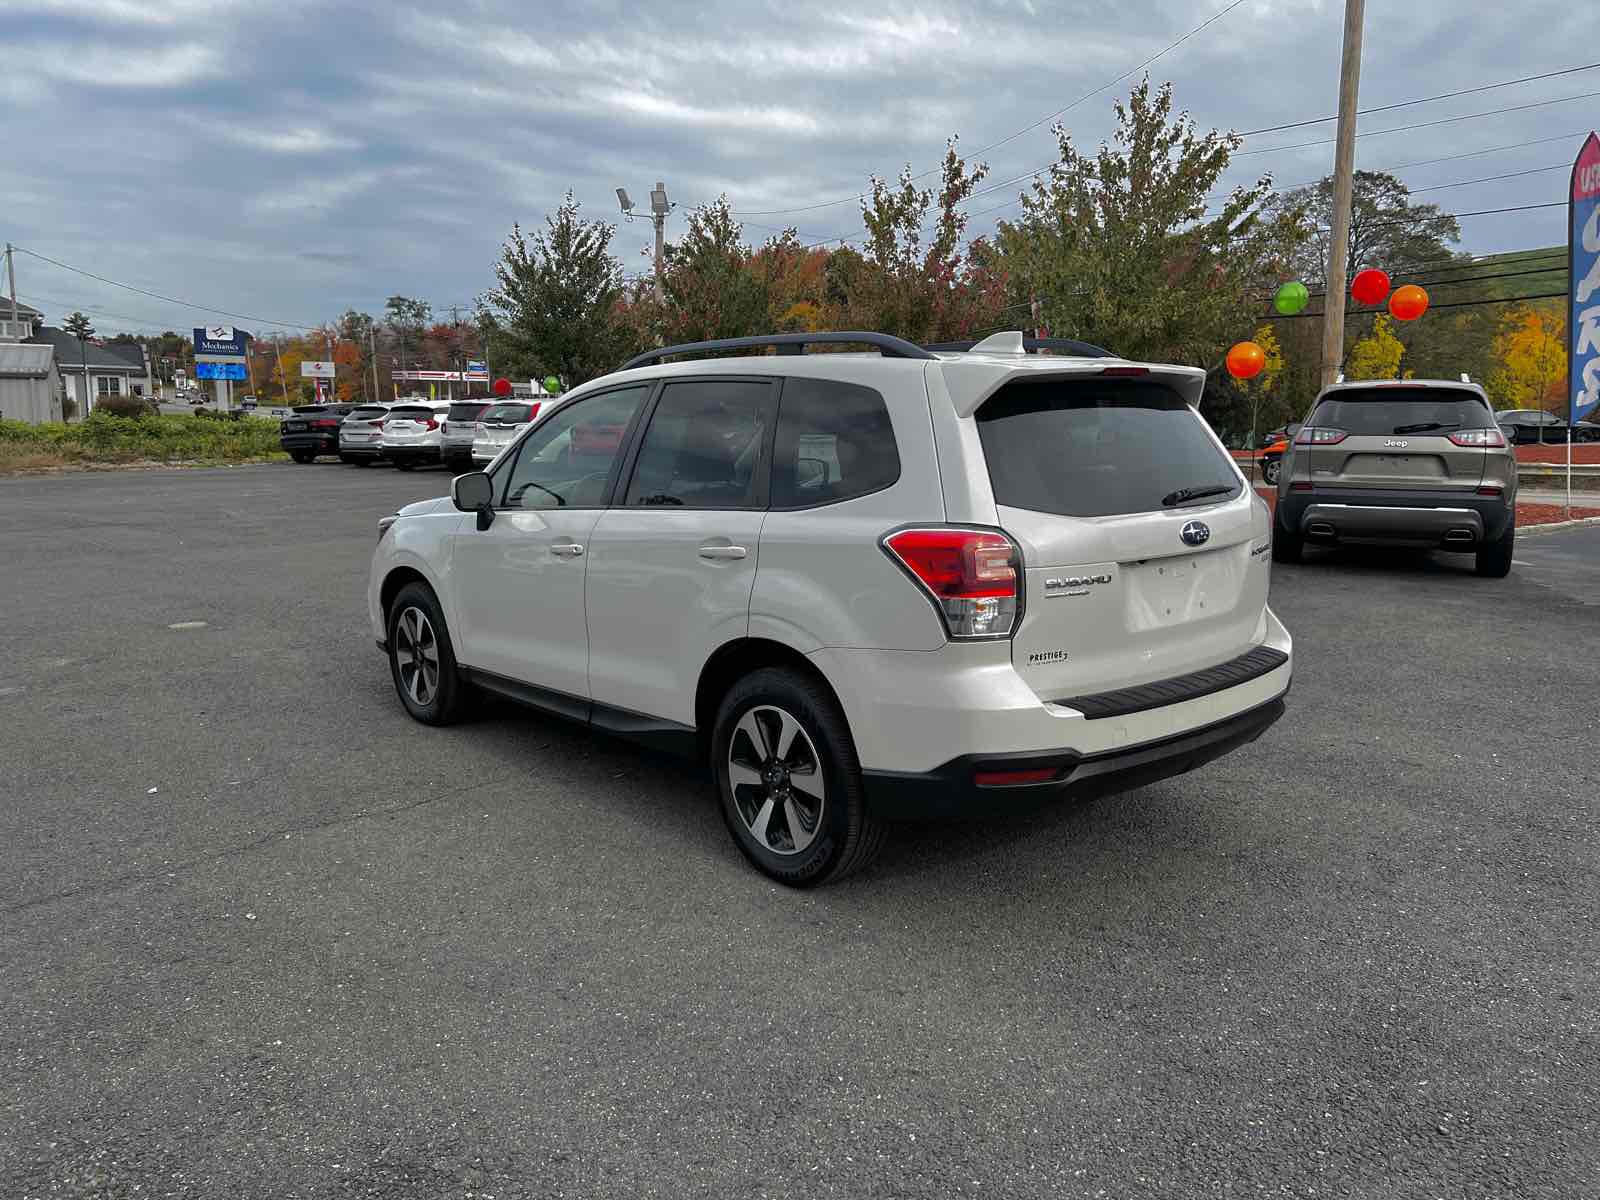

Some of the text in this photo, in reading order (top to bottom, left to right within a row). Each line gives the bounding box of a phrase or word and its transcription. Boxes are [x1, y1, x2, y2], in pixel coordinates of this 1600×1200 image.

[201, 341, 240, 351] Mechanics
[1384, 439, 1408, 448] Jeep
[1045, 575, 1112, 589] SUBARU
[1029, 650, 1063, 662] PRESTIGE
